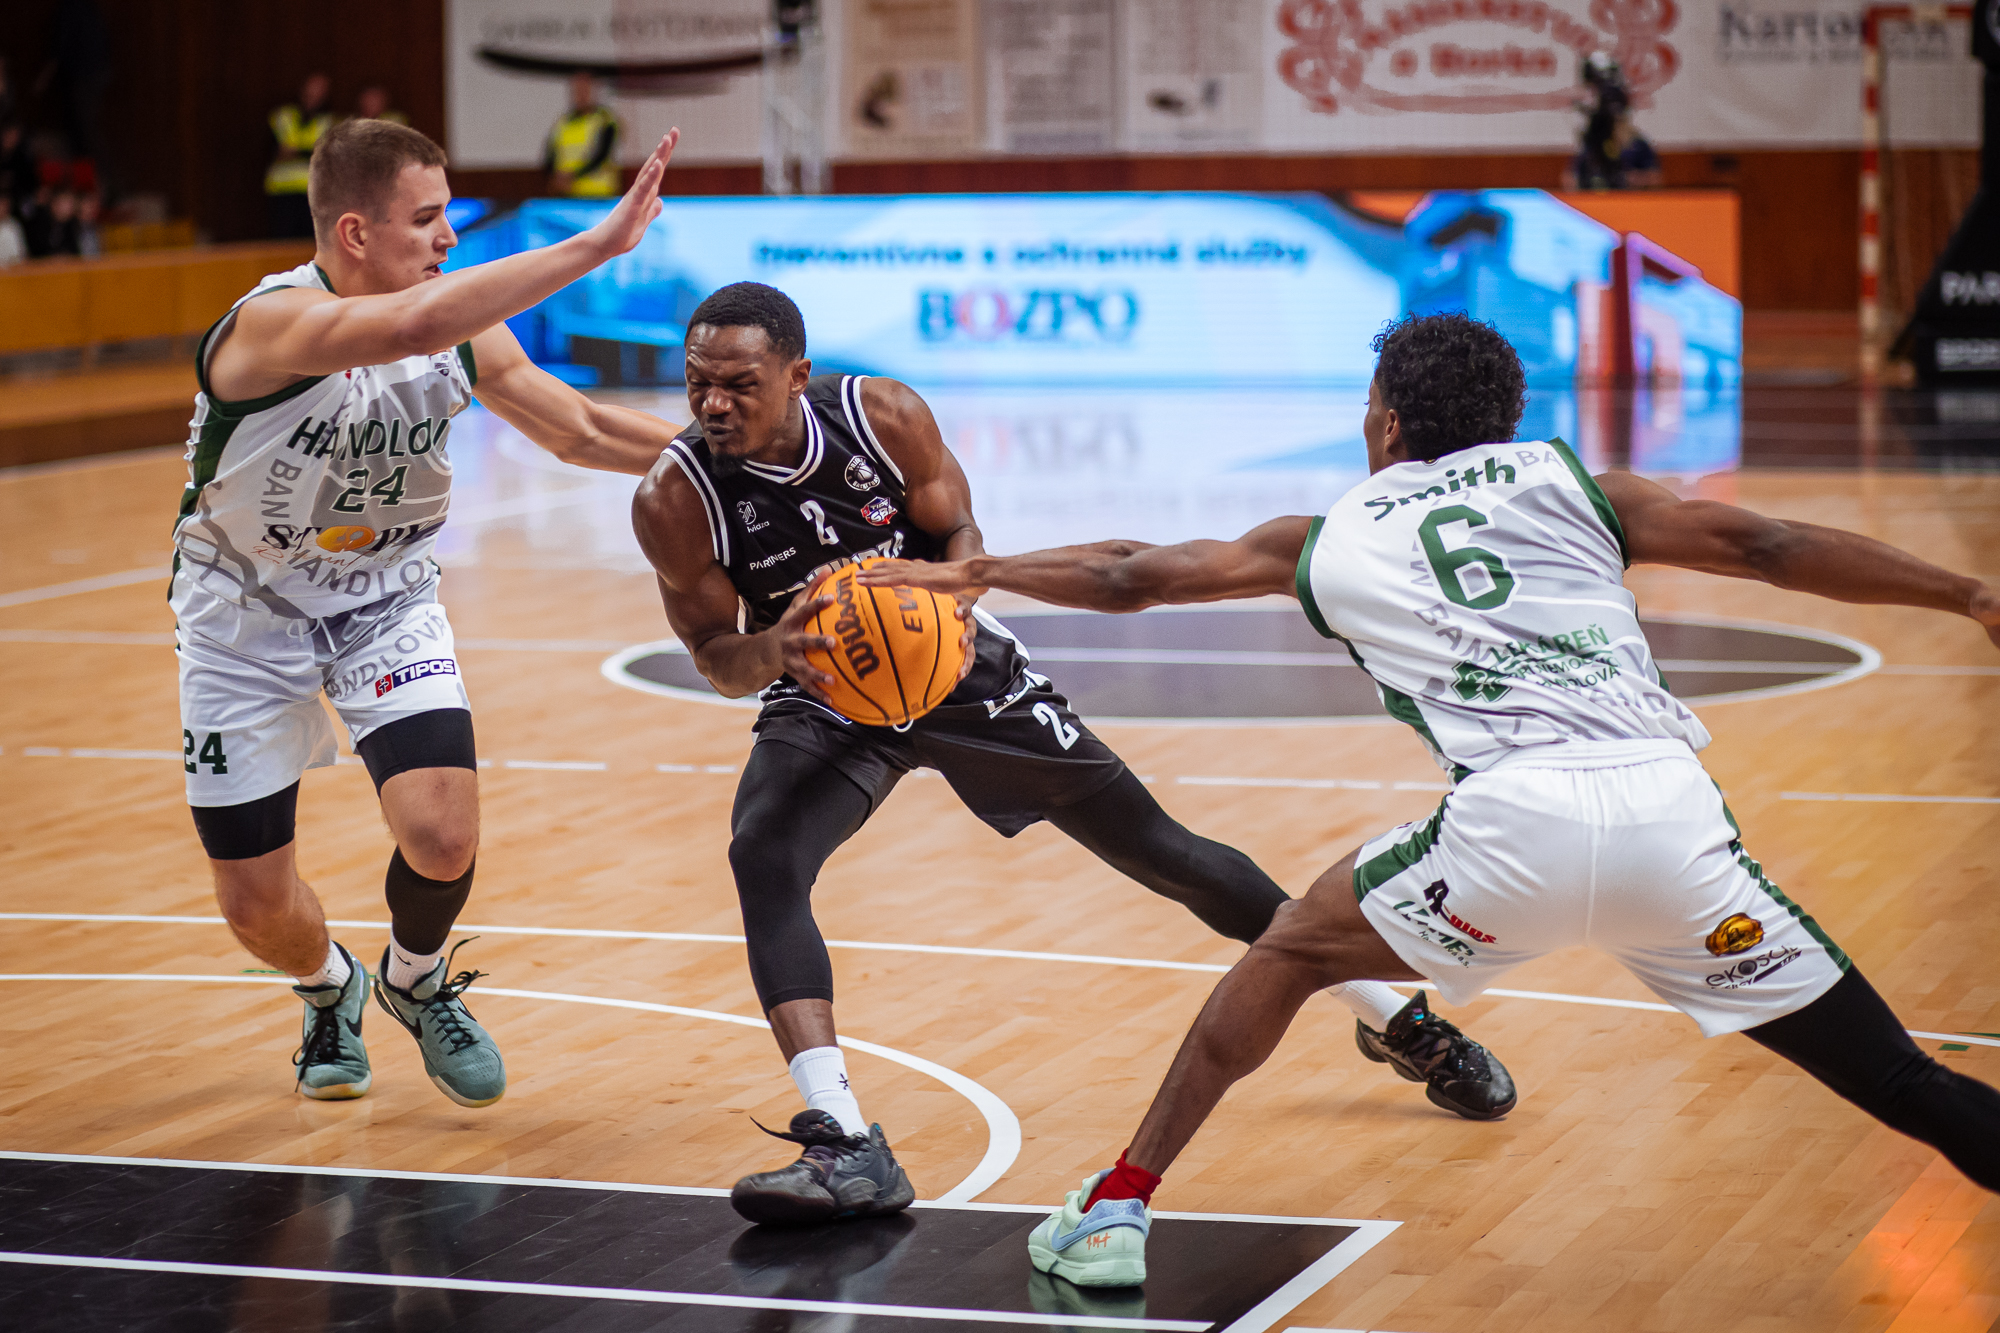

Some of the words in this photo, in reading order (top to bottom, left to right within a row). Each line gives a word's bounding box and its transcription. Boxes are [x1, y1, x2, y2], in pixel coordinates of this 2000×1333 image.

[287, 416, 450, 461] HANDLOV
[329, 464, 409, 514] 24
[1364, 457, 1516, 522] Smith
[800, 500, 839, 545] 2
[1417, 504, 1516, 610] 6
[834, 570, 880, 682] Wilson
[395, 660, 454, 683] TIPOS
[1031, 701, 1080, 751] 2
[184, 728, 228, 775] 24
